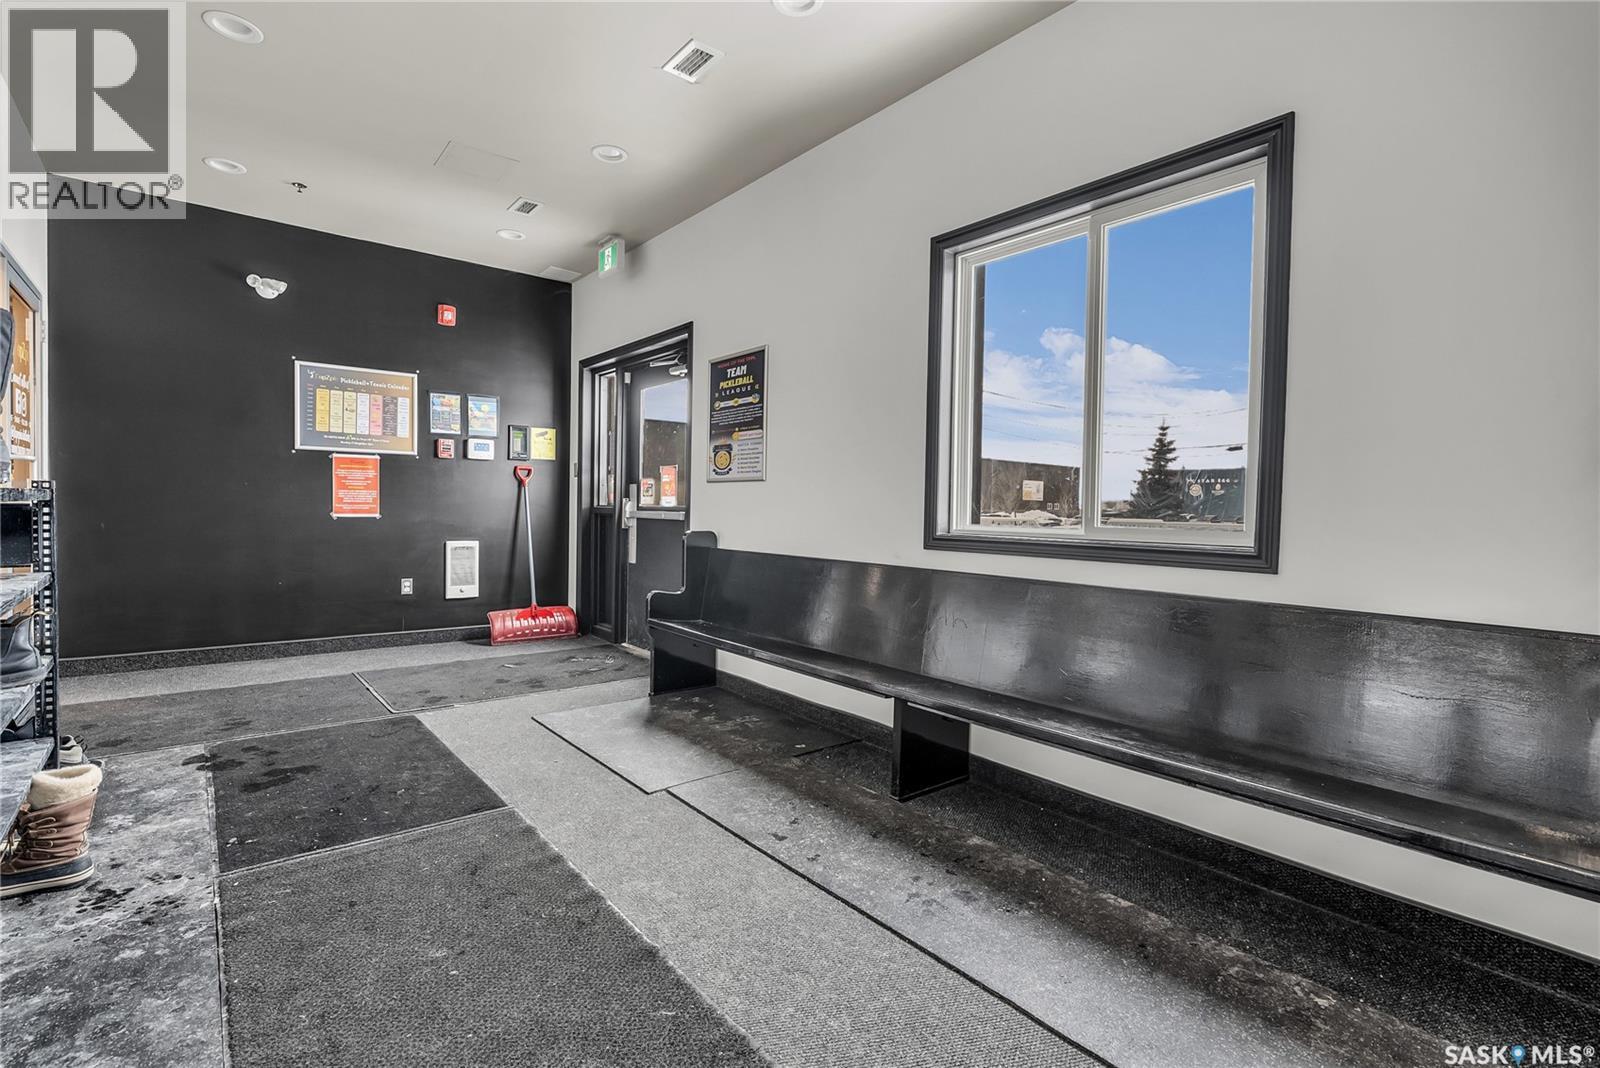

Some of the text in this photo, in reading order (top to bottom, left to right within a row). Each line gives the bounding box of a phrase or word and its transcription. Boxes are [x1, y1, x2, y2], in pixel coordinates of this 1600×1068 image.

[727, 365, 747, 378] TEAM
[719, 375, 754, 390] PICKLEBALL
[721, 385, 752, 396] LEAGUE
